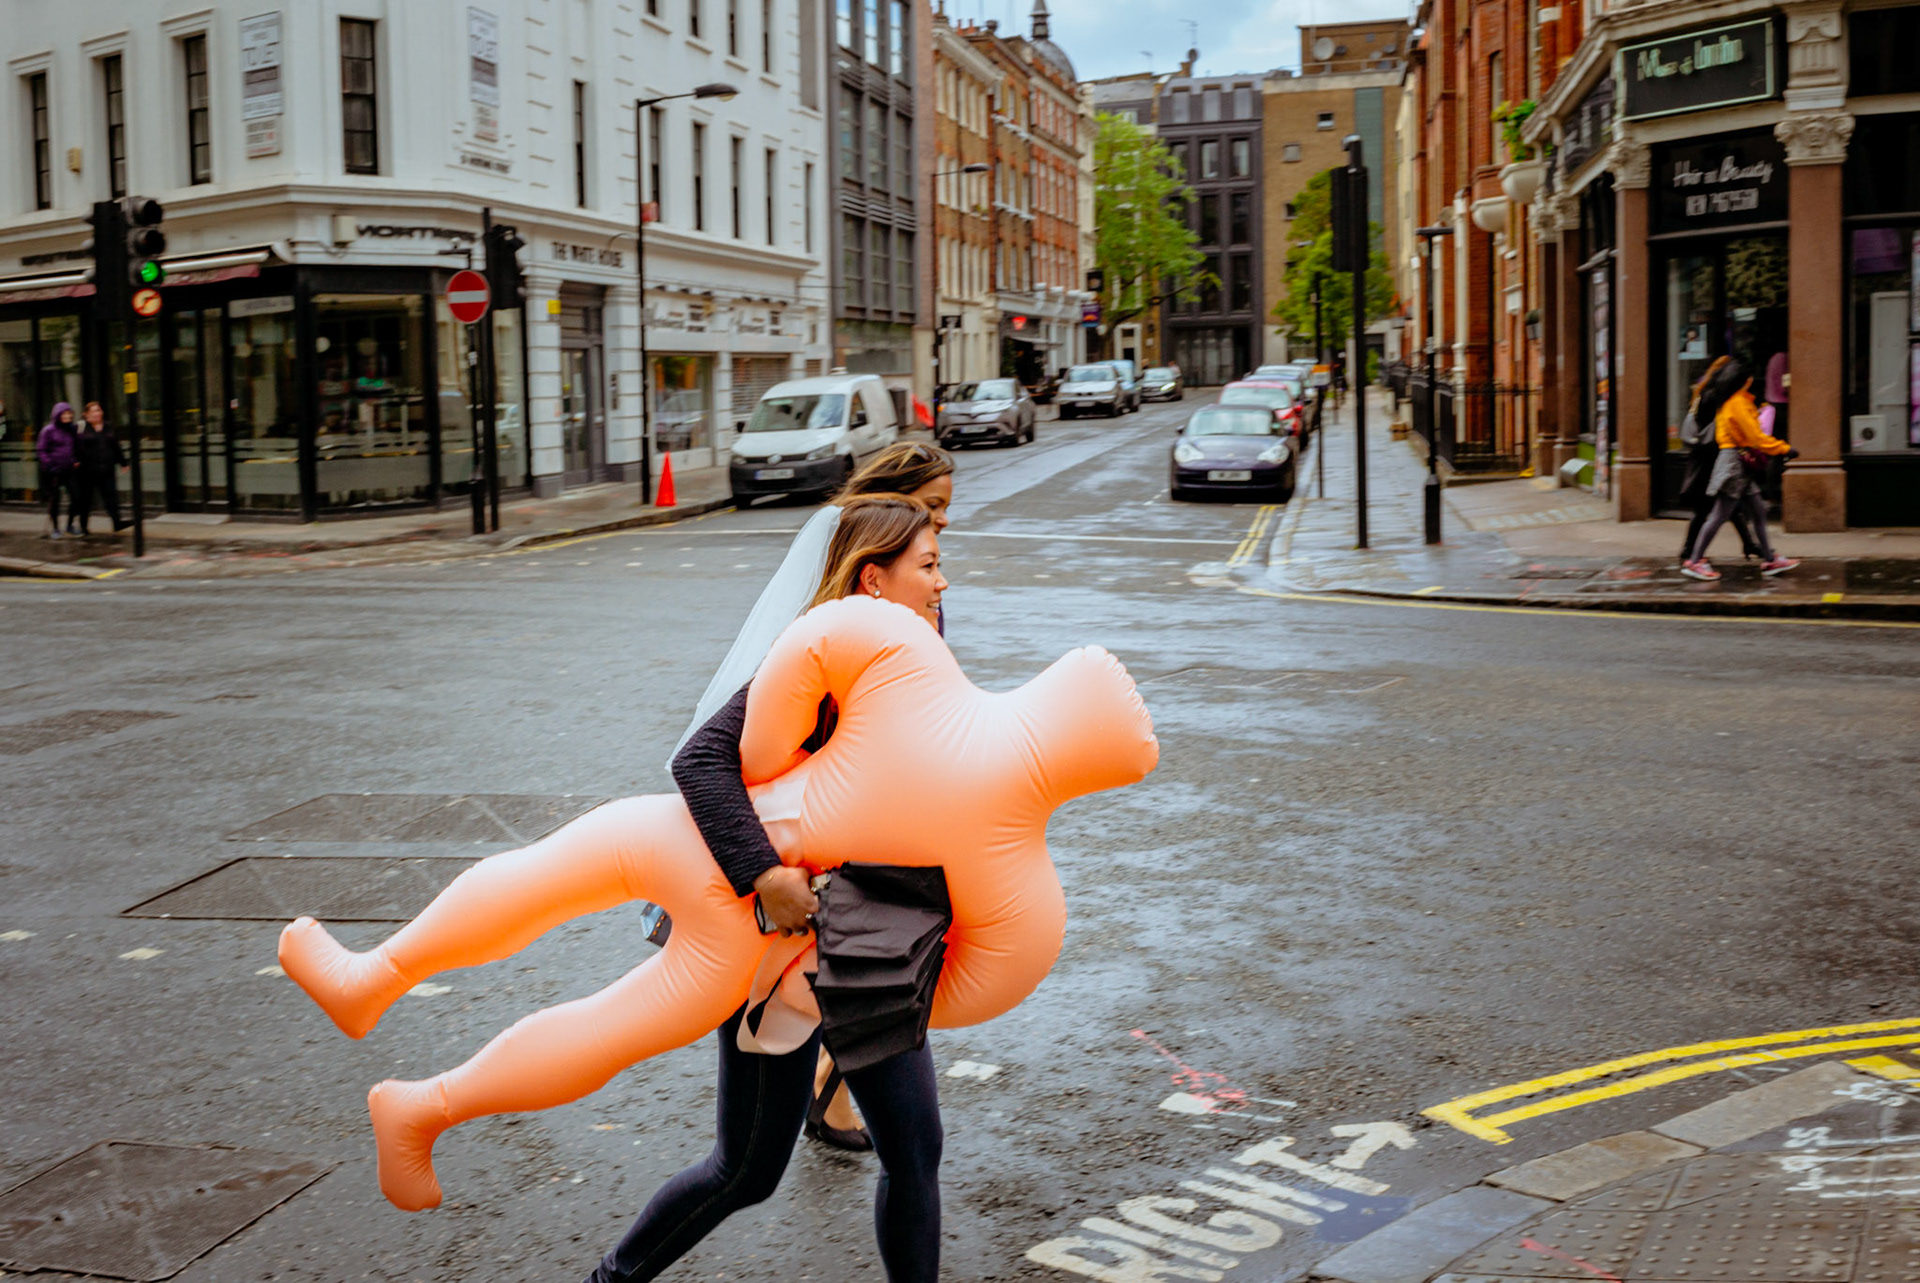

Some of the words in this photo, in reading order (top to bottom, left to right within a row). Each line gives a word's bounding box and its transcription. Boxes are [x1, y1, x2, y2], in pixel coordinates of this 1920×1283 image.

[551, 241, 568, 261] THE
[571, 244, 595, 265] WHITE
[599, 249, 625, 269] HOUSE
[1025, 1135, 1391, 1283] RIGHT
